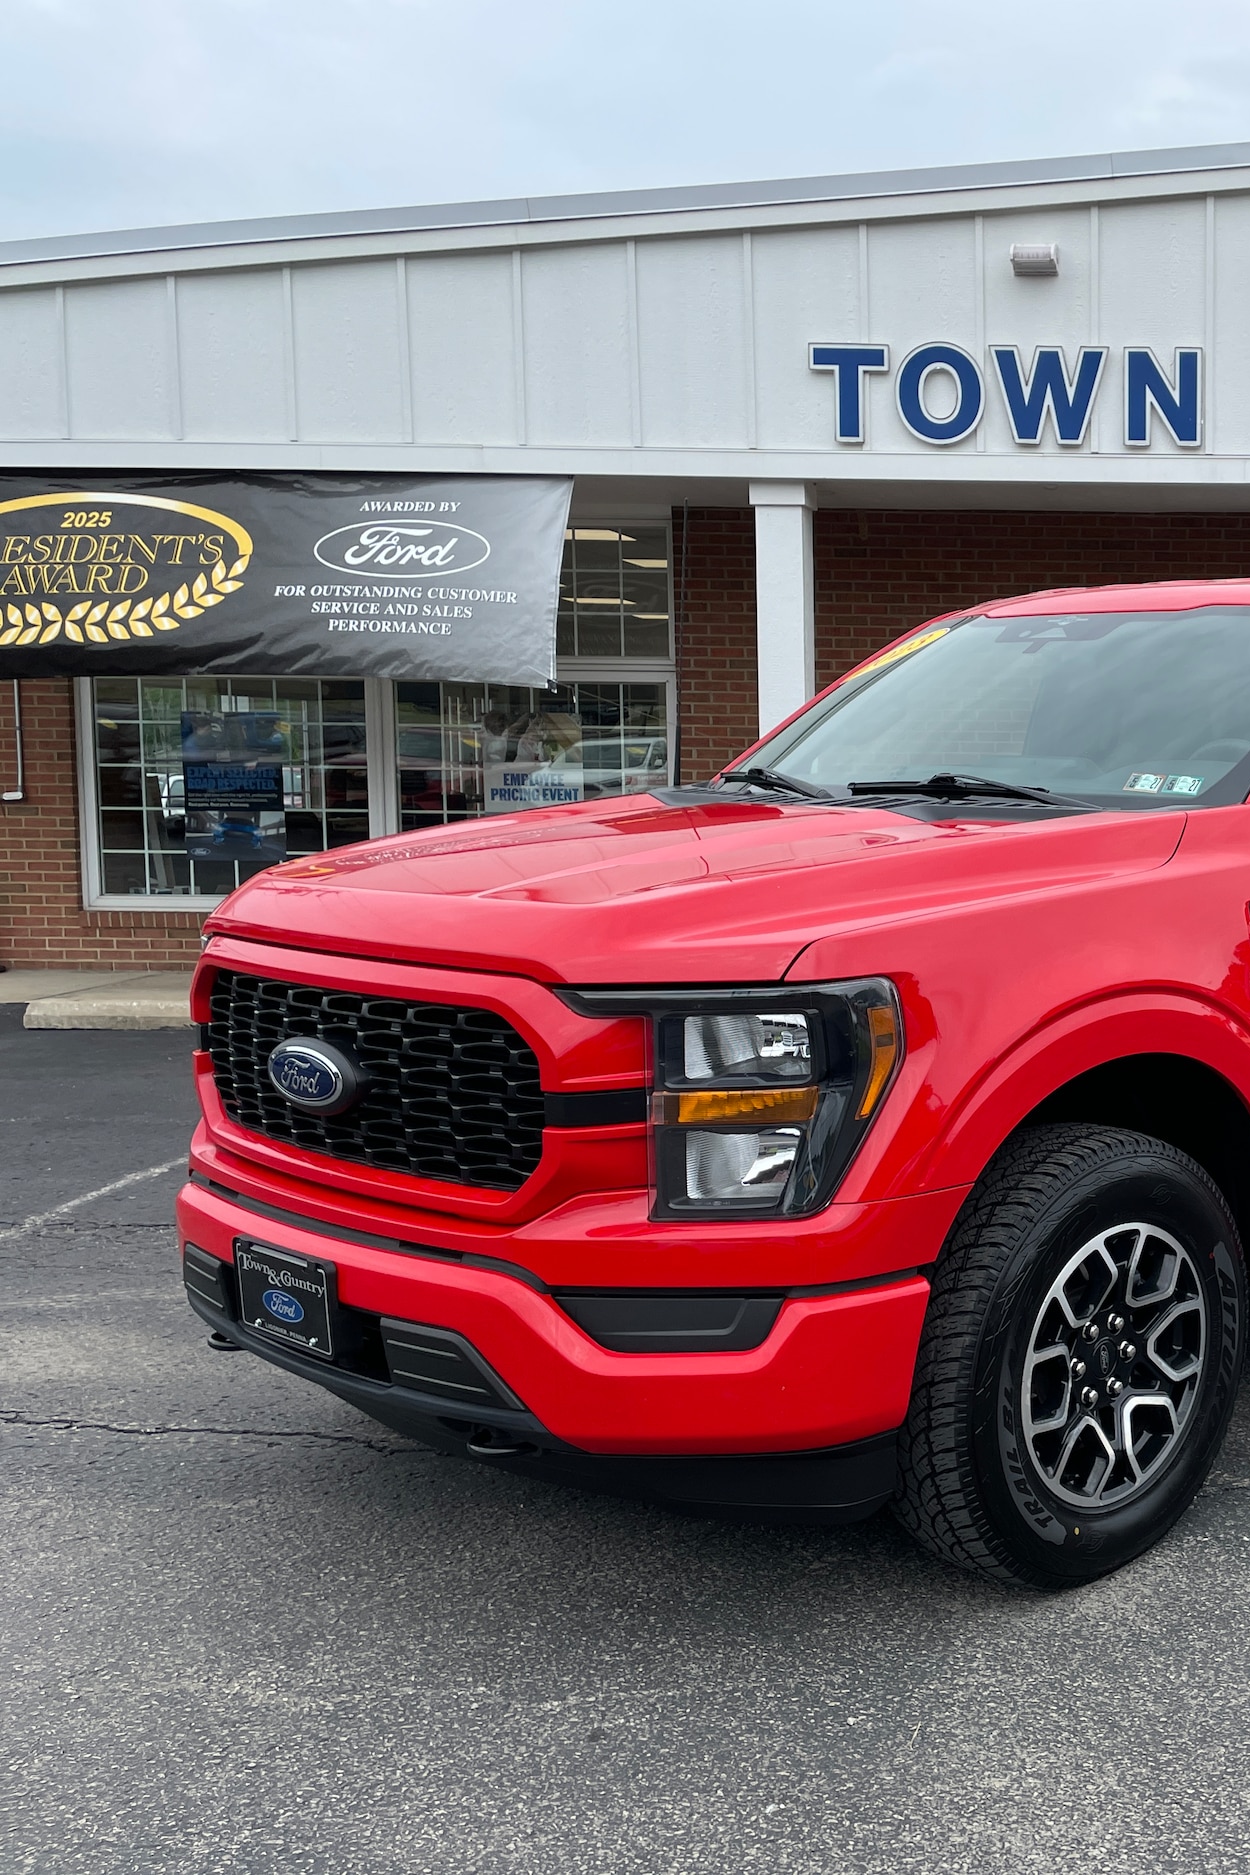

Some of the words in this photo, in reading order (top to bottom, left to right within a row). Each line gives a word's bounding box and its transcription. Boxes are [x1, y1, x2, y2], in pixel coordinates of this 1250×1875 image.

[807, 341, 1204, 447] TOWN
[359, 501, 436, 512] AWARDED
[438, 502, 461, 512] BY
[60, 511, 113, 528] 2025
[344, 526, 459, 566] Ford
[0, 564, 149, 595] AWARD
[273, 585, 306, 597] FOR
[310, 585, 422, 598] OUTSTANDING
[427, 588, 518, 604] CUSTOMER
[311, 602, 380, 614] SERVICE
[384, 603, 418, 616] AND
[422, 605, 473, 618] SALES
[328, 619, 452, 635] PERFORMANCE
[503, 772, 565, 786] EMPLOYEE
[1149, 777, 1162, 789] 27
[1187, 780, 1201, 792] 27
[490, 788, 541, 801] PRICING
[542, 788, 580, 801] EVENT
[281, 1057, 320, 1094] Ford
[270, 1292, 296, 1318] Ford
[1006, 1447, 1054, 1529] TRAIL
